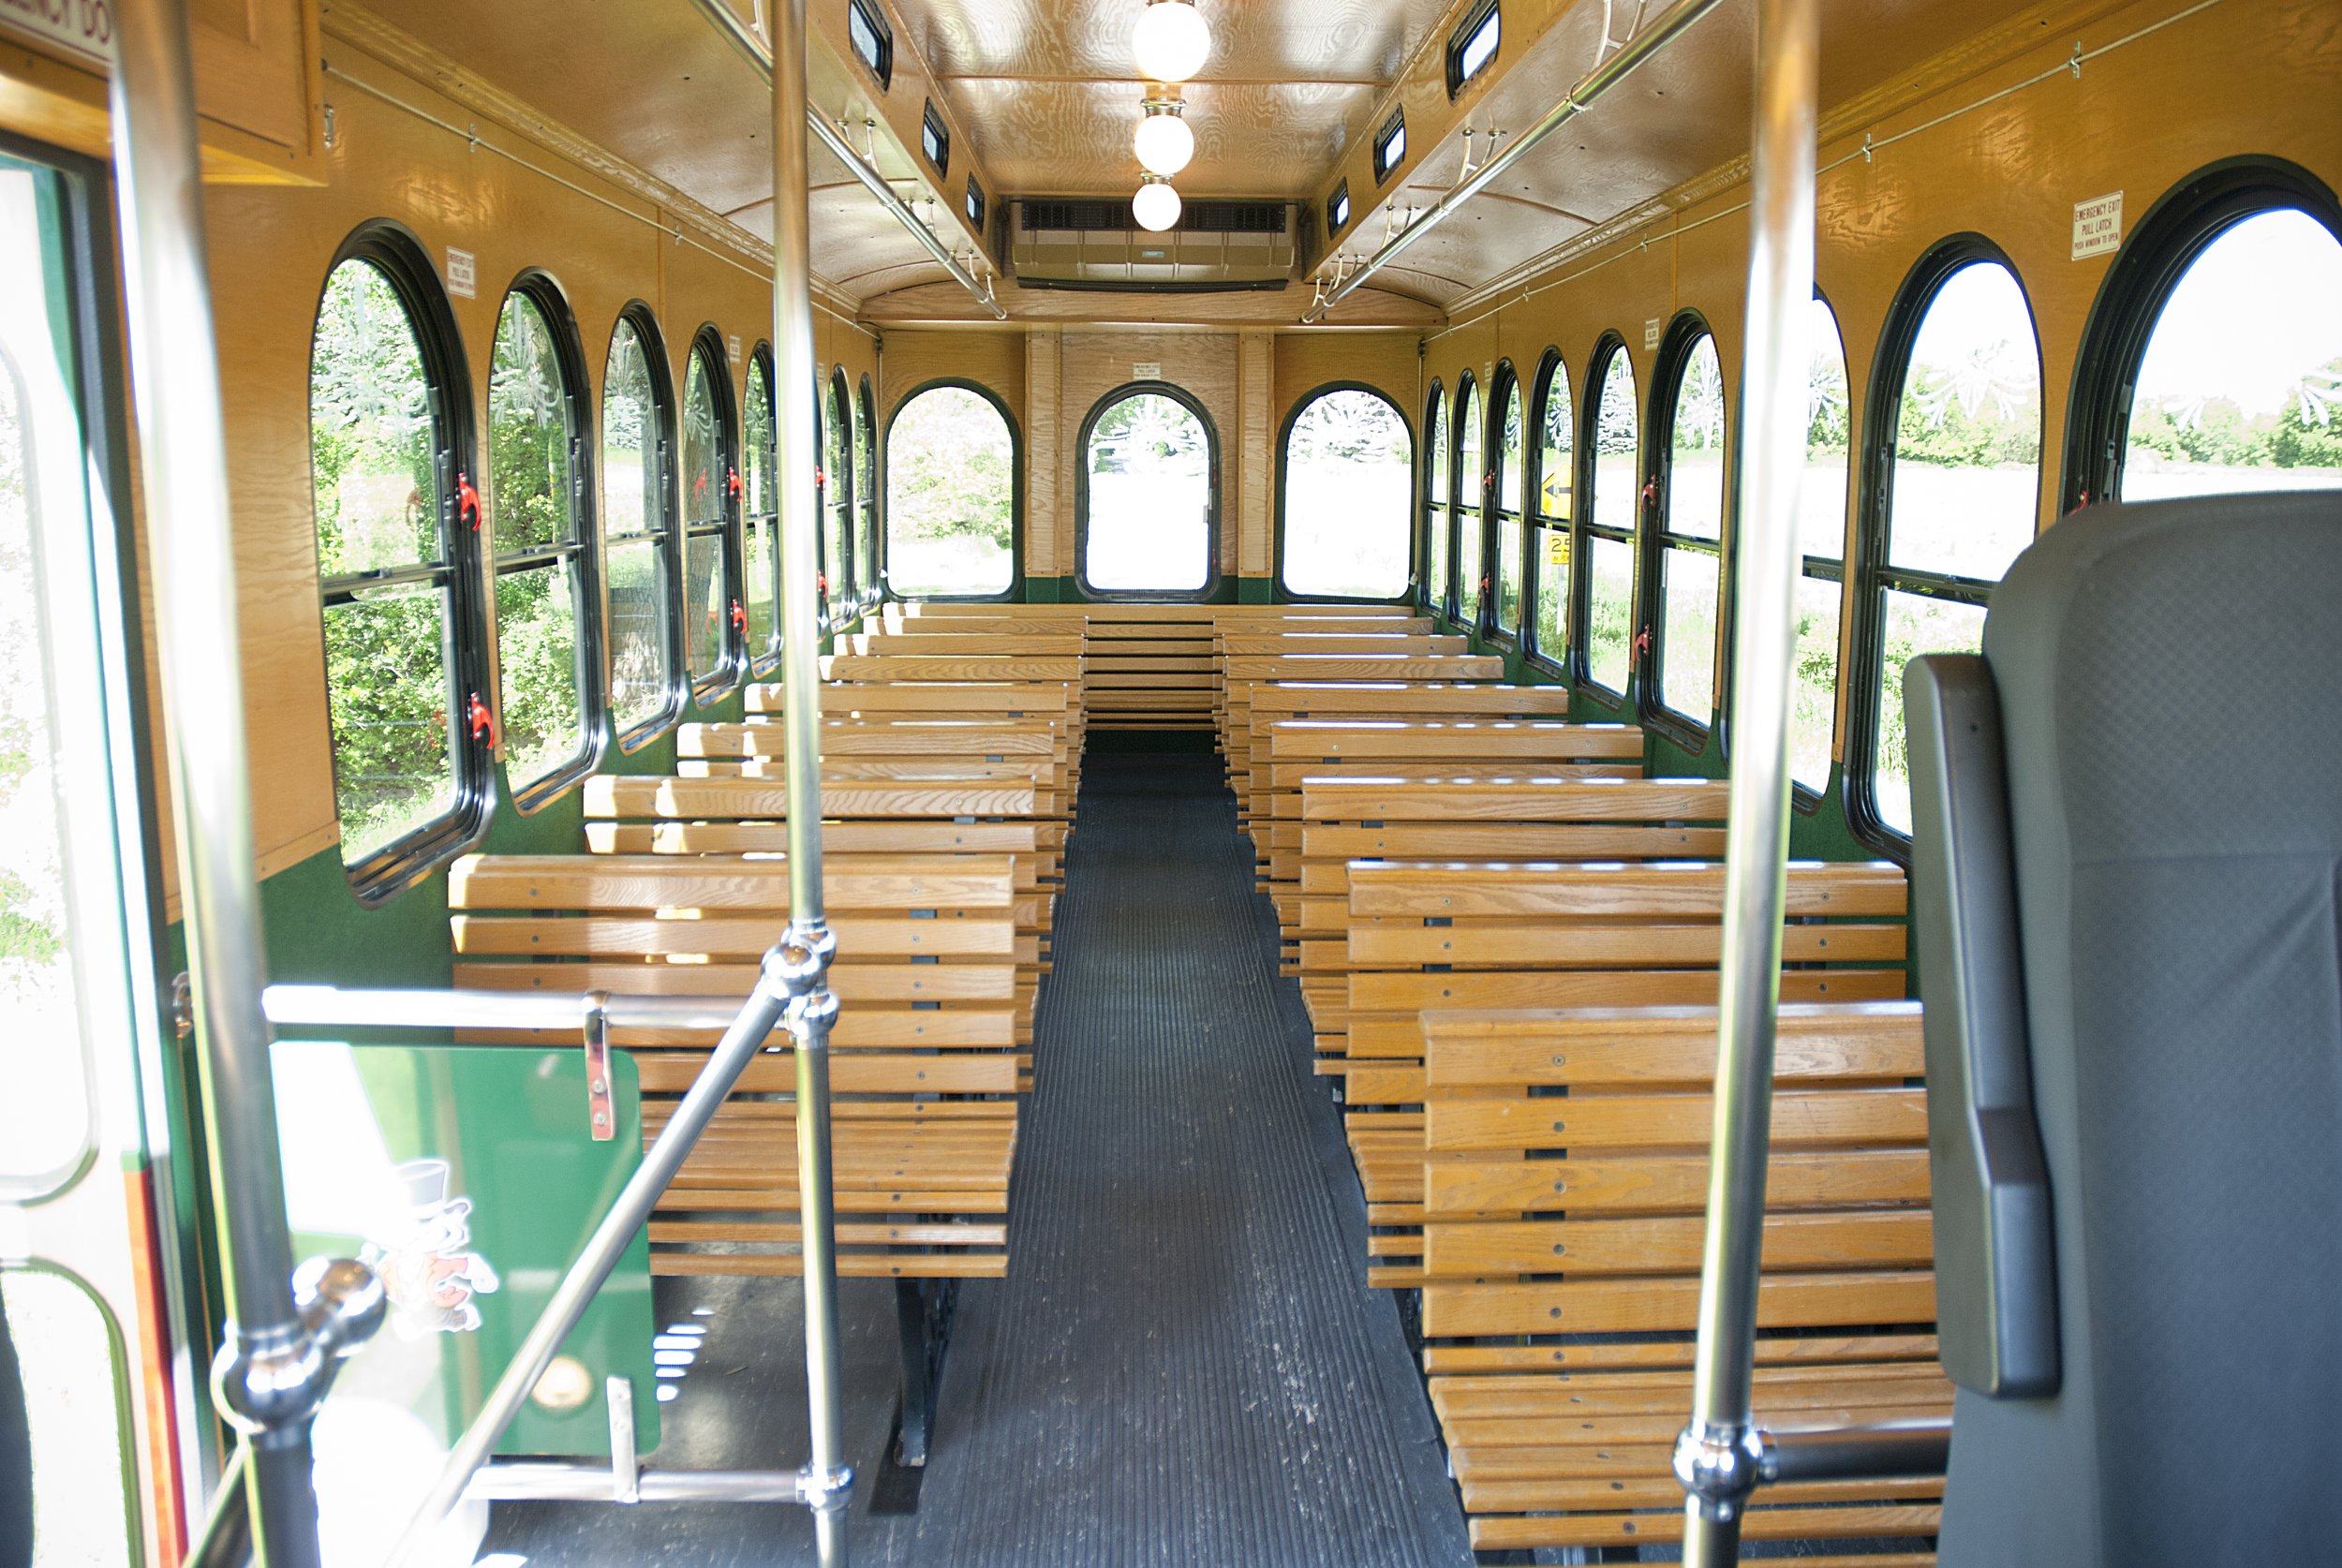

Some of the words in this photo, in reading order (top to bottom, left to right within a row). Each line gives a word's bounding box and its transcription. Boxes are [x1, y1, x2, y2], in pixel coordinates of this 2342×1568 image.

[2075, 203, 2107, 222] EMERGENCY
[2108, 199, 2120, 214] EXIT
[2082, 224, 2095, 236] PULL
[2096, 218, 2112, 232] LATCH
[2085, 237, 2100, 247] WINDOW
[2102, 234, 2107, 244] TO
[2108, 232, 2118, 242] OPEN
[1551, 538, 1570, 553] 25
